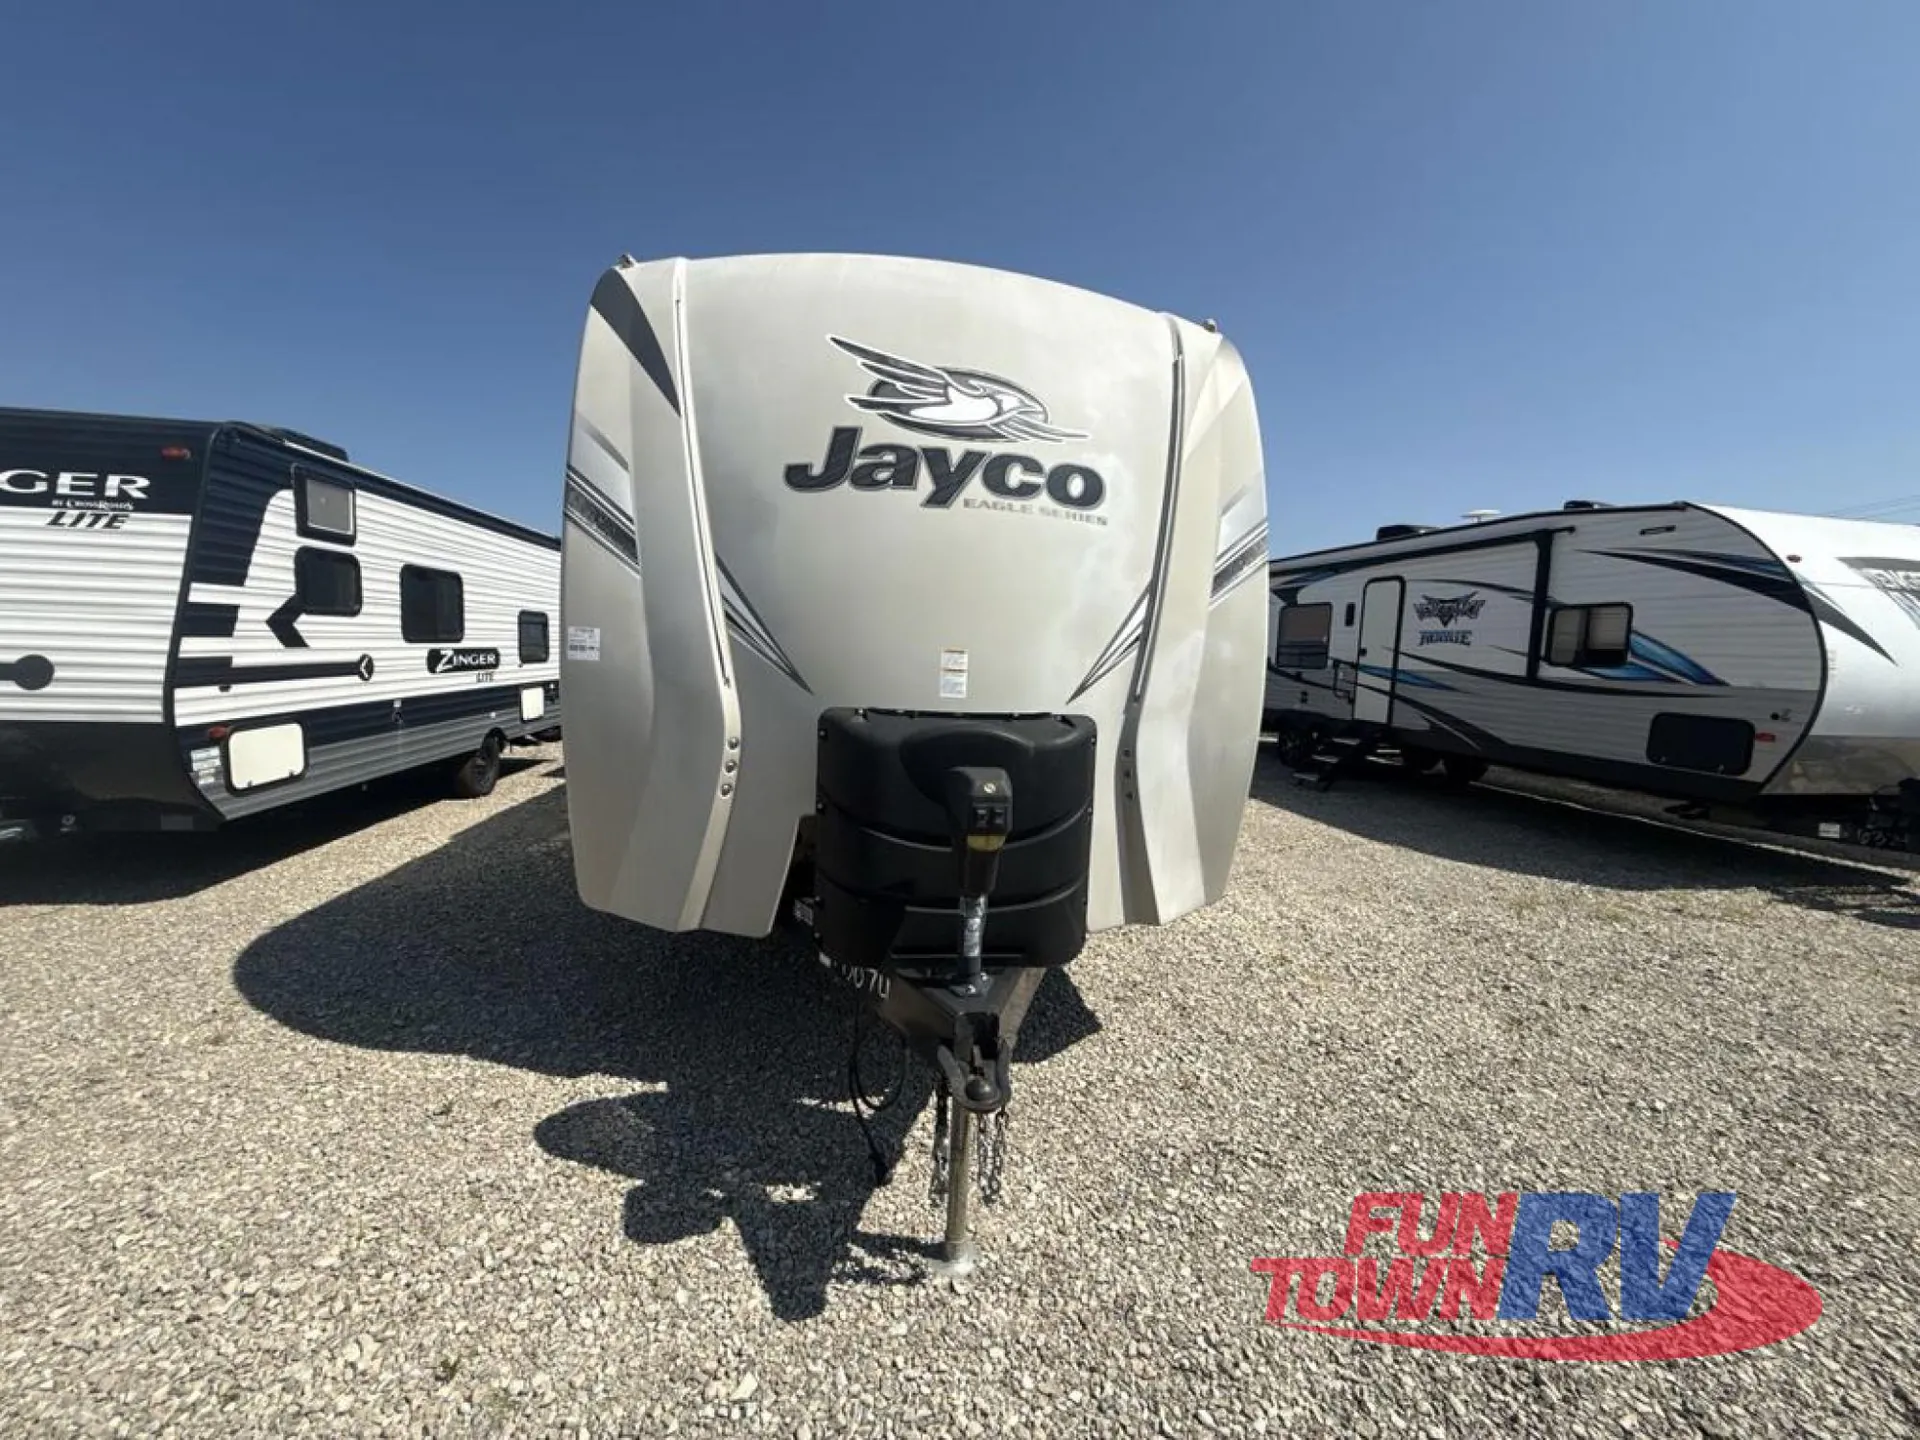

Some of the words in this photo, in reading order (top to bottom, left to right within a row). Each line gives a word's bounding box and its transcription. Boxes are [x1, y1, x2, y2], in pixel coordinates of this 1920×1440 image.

[784, 425, 1107, 510] Jayco
[0, 468, 151, 499] GER
[46, 510, 130, 530] LITE
[964, 497, 1034, 515] EAGLE
[1037, 505, 1108, 526] SERIES
[435, 649, 497, 673] ZINGER
